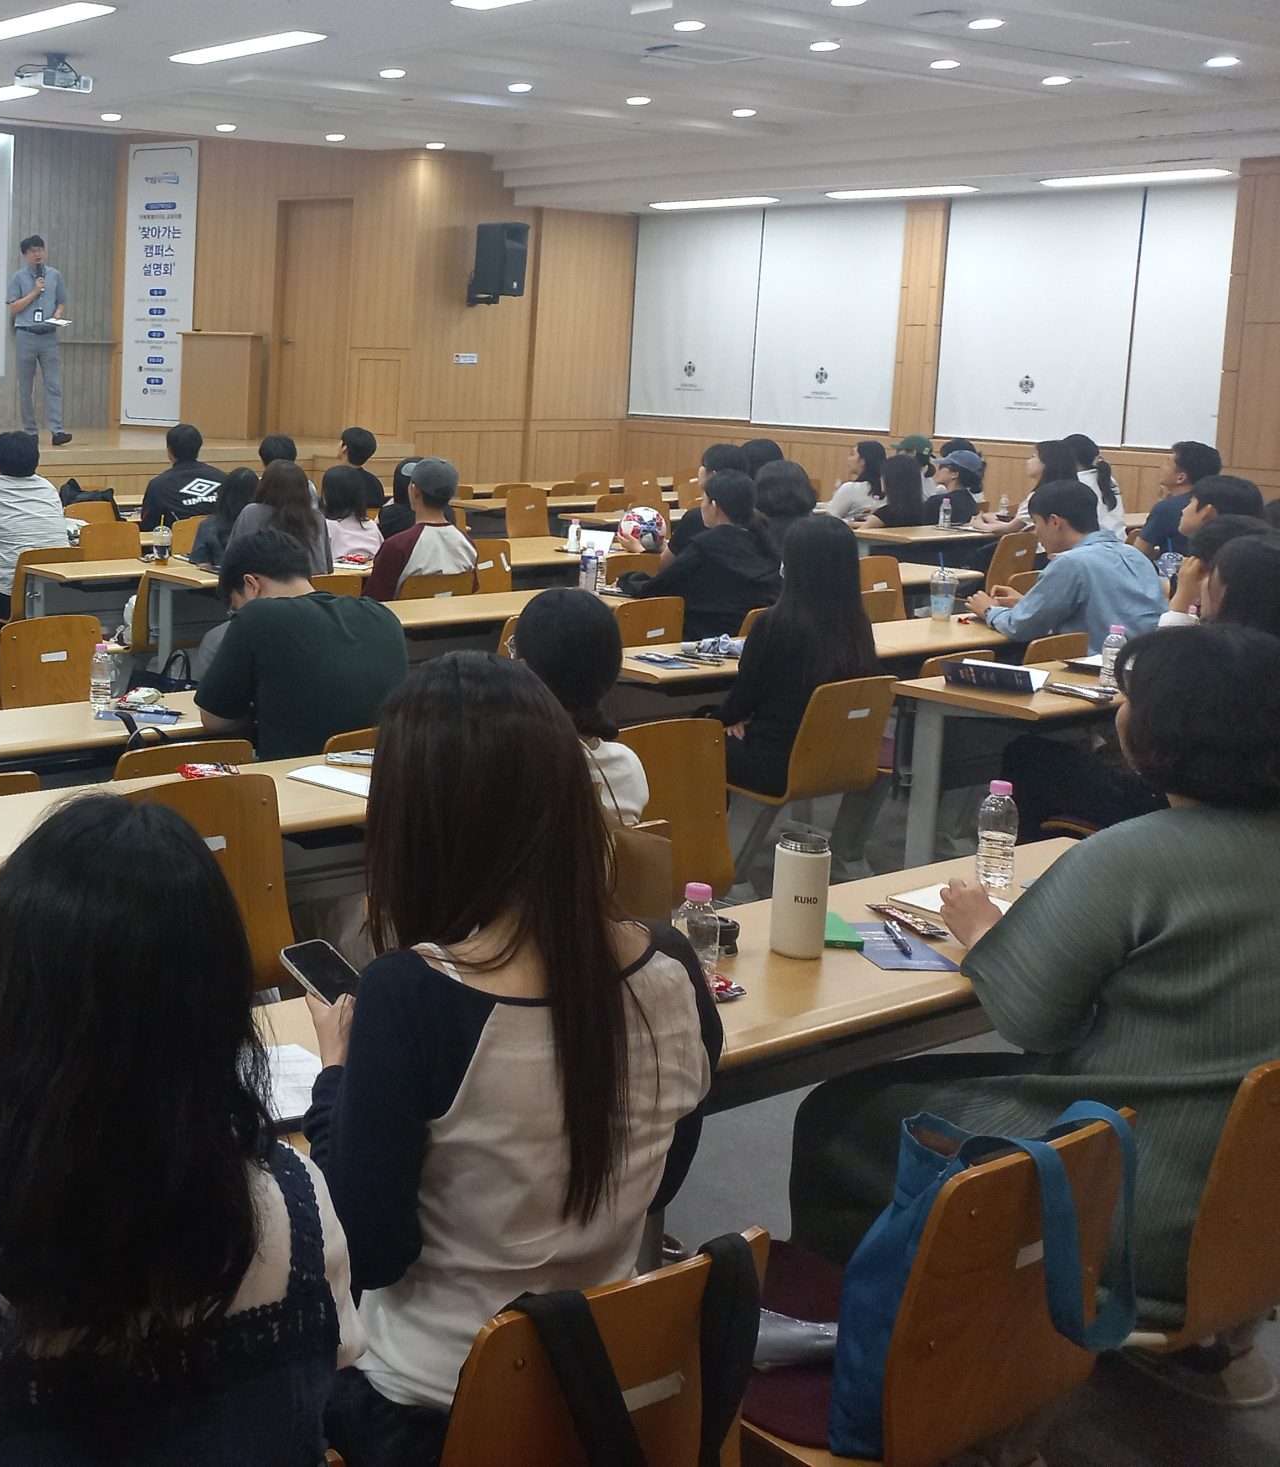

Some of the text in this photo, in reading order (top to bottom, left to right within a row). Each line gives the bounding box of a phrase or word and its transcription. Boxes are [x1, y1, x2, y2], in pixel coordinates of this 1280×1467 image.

[144, 244, 175, 258] 캠퍼스
[182, 495, 218, 505] UMBR
[794, 895, 818, 904] KUHO
